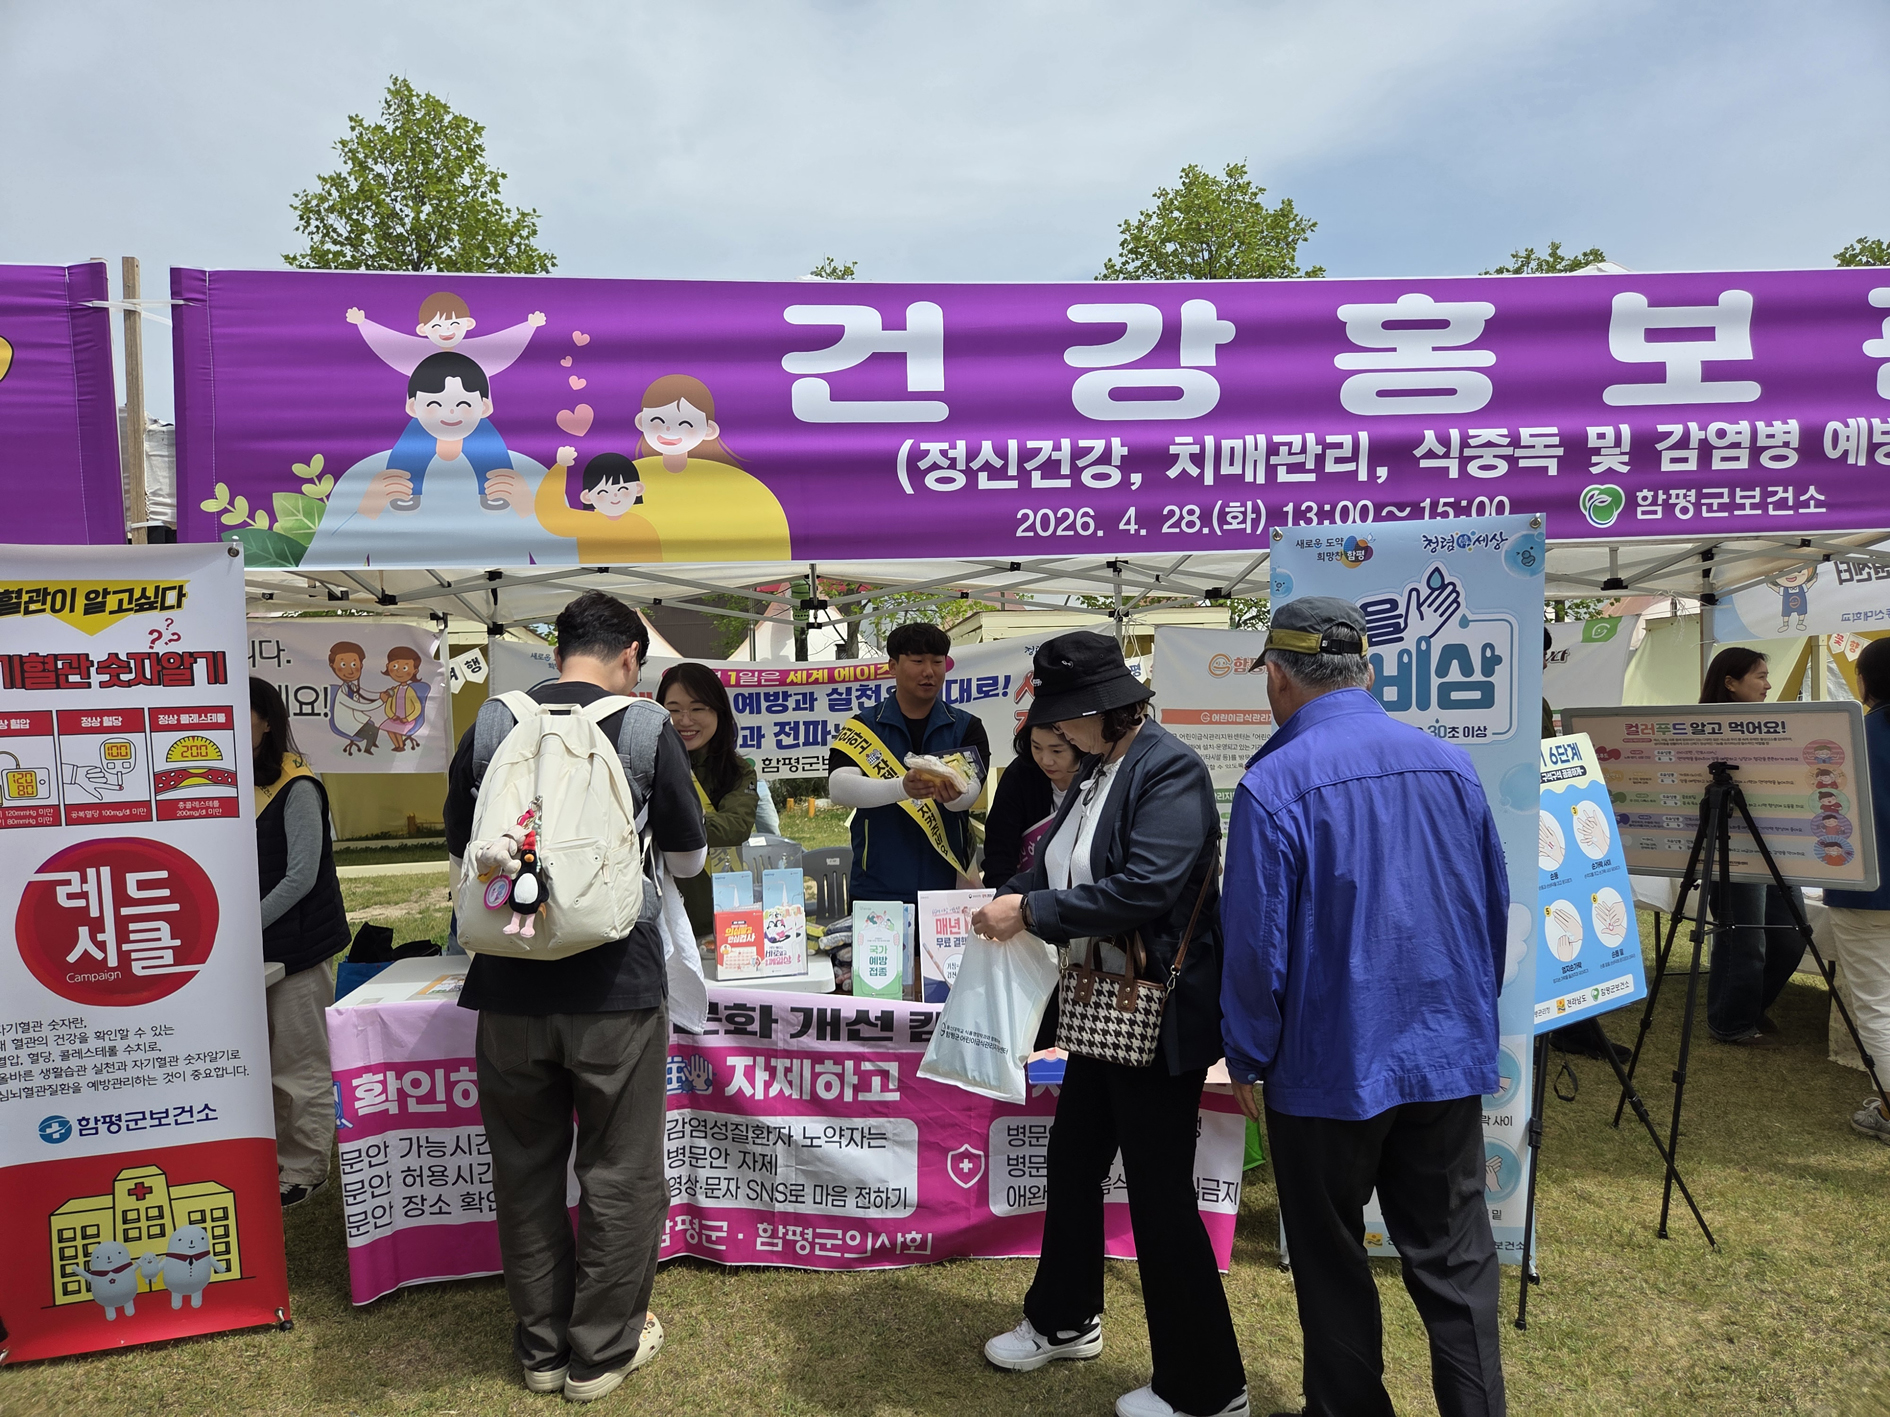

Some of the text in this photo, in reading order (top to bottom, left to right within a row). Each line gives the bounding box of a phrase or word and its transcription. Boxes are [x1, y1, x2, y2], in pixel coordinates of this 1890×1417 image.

[897, 418, 1800, 494] (정신건강, 치매관리, 식중독 및 감염병
[1636, 485, 1827, 520] 함평군보건소
[1015, 508, 1104, 538] 2026.
[1118, 507, 1147, 537] 4.
[1161, 501, 1267, 536] 28.(화)
[1295, 537, 1344, 549] 새로운 도약
[1317, 550, 1365, 562] 희망찬 함평
[83, 585, 187, 616] 알고싶다
[96, 651, 228, 688] 숫자알기
[727, 670, 780, 686] 1일은
[786, 668, 828, 685] 세계
[732, 689, 817, 716] 예방과
[10, 719, 30, 730] 혈압
[81, 716, 122, 727] 정상 혈당
[158, 713, 226, 724] 정상 콜레스테롤
[1462, 725, 1488, 738] 이상
[1624, 720, 1787, 736] 컬러푸드 알고 먹어요!
[107, 743, 129, 757] 100
[181, 744, 208, 759] 200
[1549, 741, 1583, 766] 6단계
[13, 772, 33, 784] 120
[17, 785, 35, 796] 80
[5, 807, 54, 817] 120mmHg 미만
[6, 816, 53, 826] 80mmHg 미만
[70, 809, 99, 819] 공복혈당
[132, 807, 147, 816] 미만
[208, 808, 222, 817] 미만
[34, 866, 180, 917] 레드
[935, 917, 961, 935] 매년
[869, 945, 888, 955] 국가
[936, 937, 951, 948] 무료
[868, 956, 888, 966] 예방
[66, 970, 122, 983] Campaign
[868, 967, 888, 977] 접종
[1600, 980, 1630, 997] 함평군보건소
[1566, 994, 1587, 1008] 전라남도
[789, 1006, 894, 1043] 개선
[11, 1034, 48, 1051] 혈관의
[53, 1031, 90, 1046] 건강을
[93, 1027, 130, 1042] 확인할
[133, 1026, 147, 1039] 수
[150, 1024, 175, 1037] 있는
[58, 1044, 119, 1062] 콜레스테롤
[39, 1064, 88, 1081] 생활습관
[91, 1060, 128, 1075] 실천과
[131, 1054, 179, 1071] 자기혈관
[183, 1049, 241, 1066] 숫자알기로
[86, 1074, 159, 1091] 예방관리하는
[162, 1070, 187, 1085] 것이
[190, 1064, 250, 1081] 중요합니다.
[724, 1056, 901, 1102] 자제하고
[76, 1102, 219, 1137] 함평군보건소
[1493, 1115, 1513, 1127] 사이
[666, 1117, 888, 1150] 감염성질환자 노약자는
[1007, 1123, 1052, 1148] 병문
[340, 1140, 389, 1175] 문안
[666, 1145, 778, 1176] 병문안 자제
[344, 1171, 392, 1207] 문안
[746, 1179, 806, 1204] SNS로
[813, 1184, 848, 1209] 마음
[855, 1187, 908, 1210] 전하기
[347, 1201, 393, 1239] 문안
[402, 1194, 452, 1218] 장소
[756, 1222, 932, 1258] 함평군의사회
